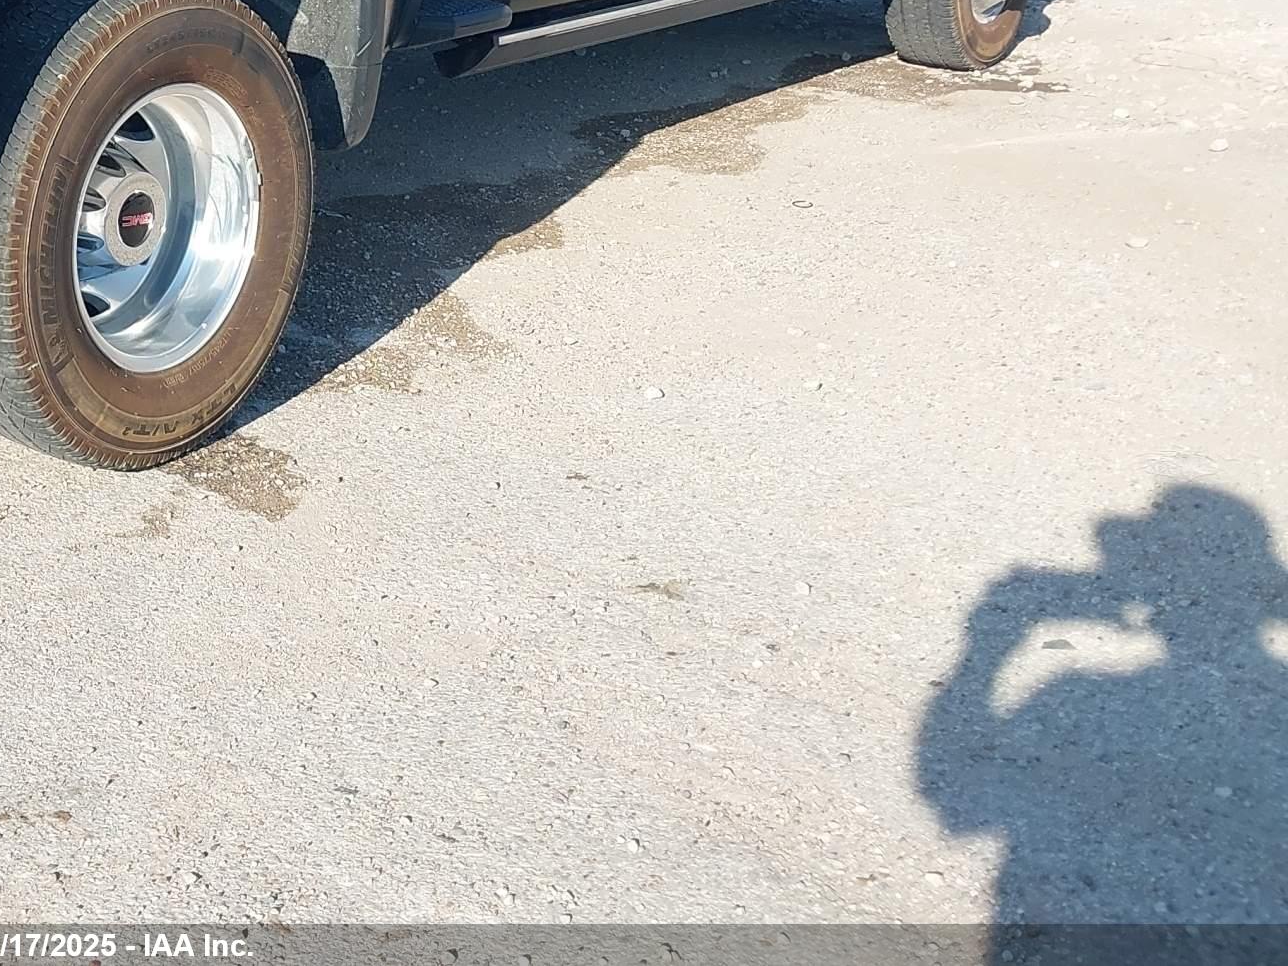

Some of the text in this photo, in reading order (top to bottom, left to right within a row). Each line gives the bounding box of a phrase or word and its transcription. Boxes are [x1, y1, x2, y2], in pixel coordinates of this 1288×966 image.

[122, 213, 153, 227] GMC
[39, 164, 68, 327] MICHELIN
[191, 382, 240, 425] LTX
